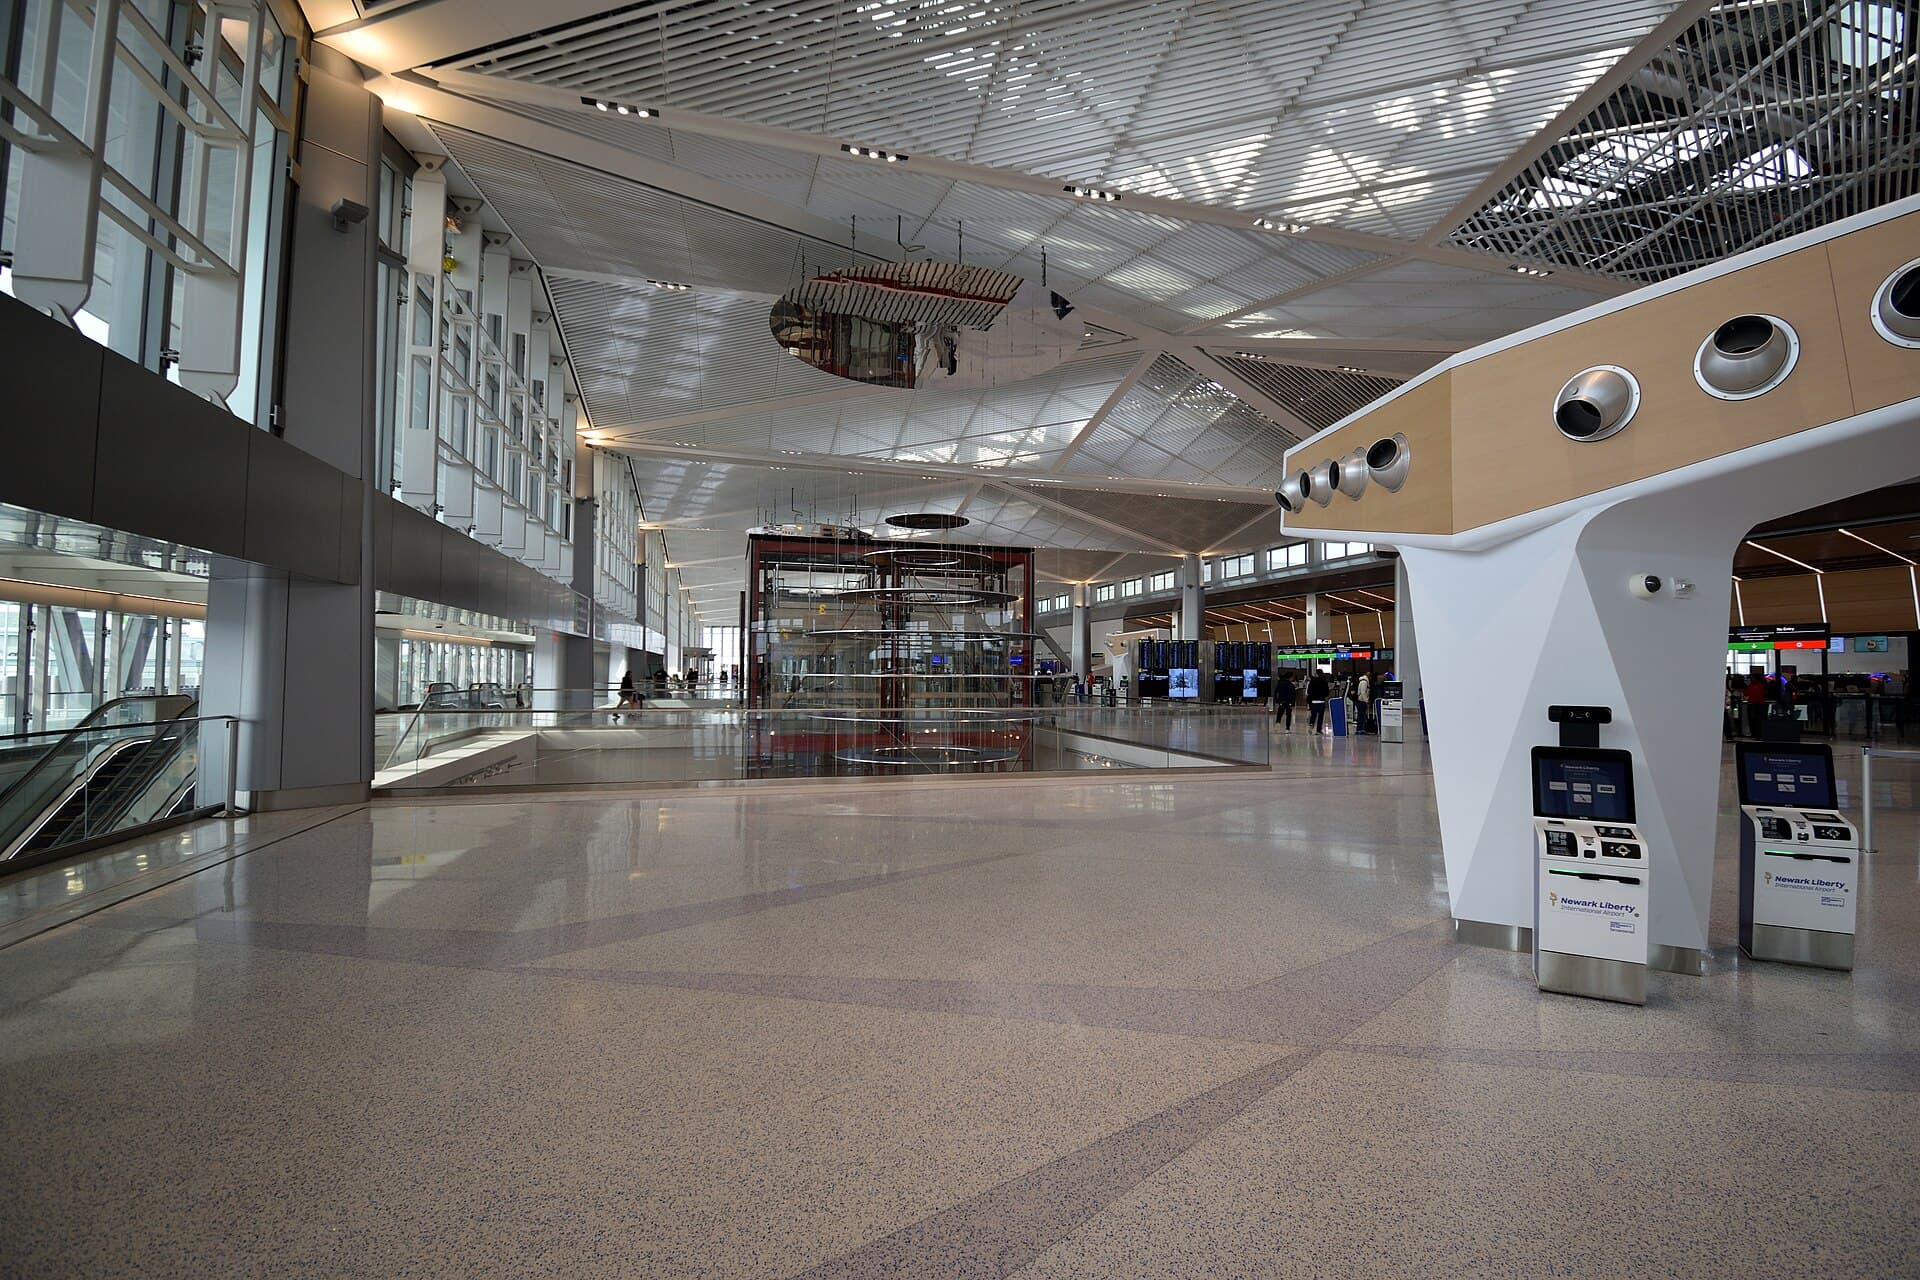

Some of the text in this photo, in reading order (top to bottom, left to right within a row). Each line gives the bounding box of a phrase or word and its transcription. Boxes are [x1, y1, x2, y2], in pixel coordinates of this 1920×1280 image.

[1775, 875, 1845, 889] Newark Liberty
[1775, 882, 1814, 891] International
[1561, 897, 1636, 914] Newark Liberty
[1561, 904, 1625, 917] International Airport
